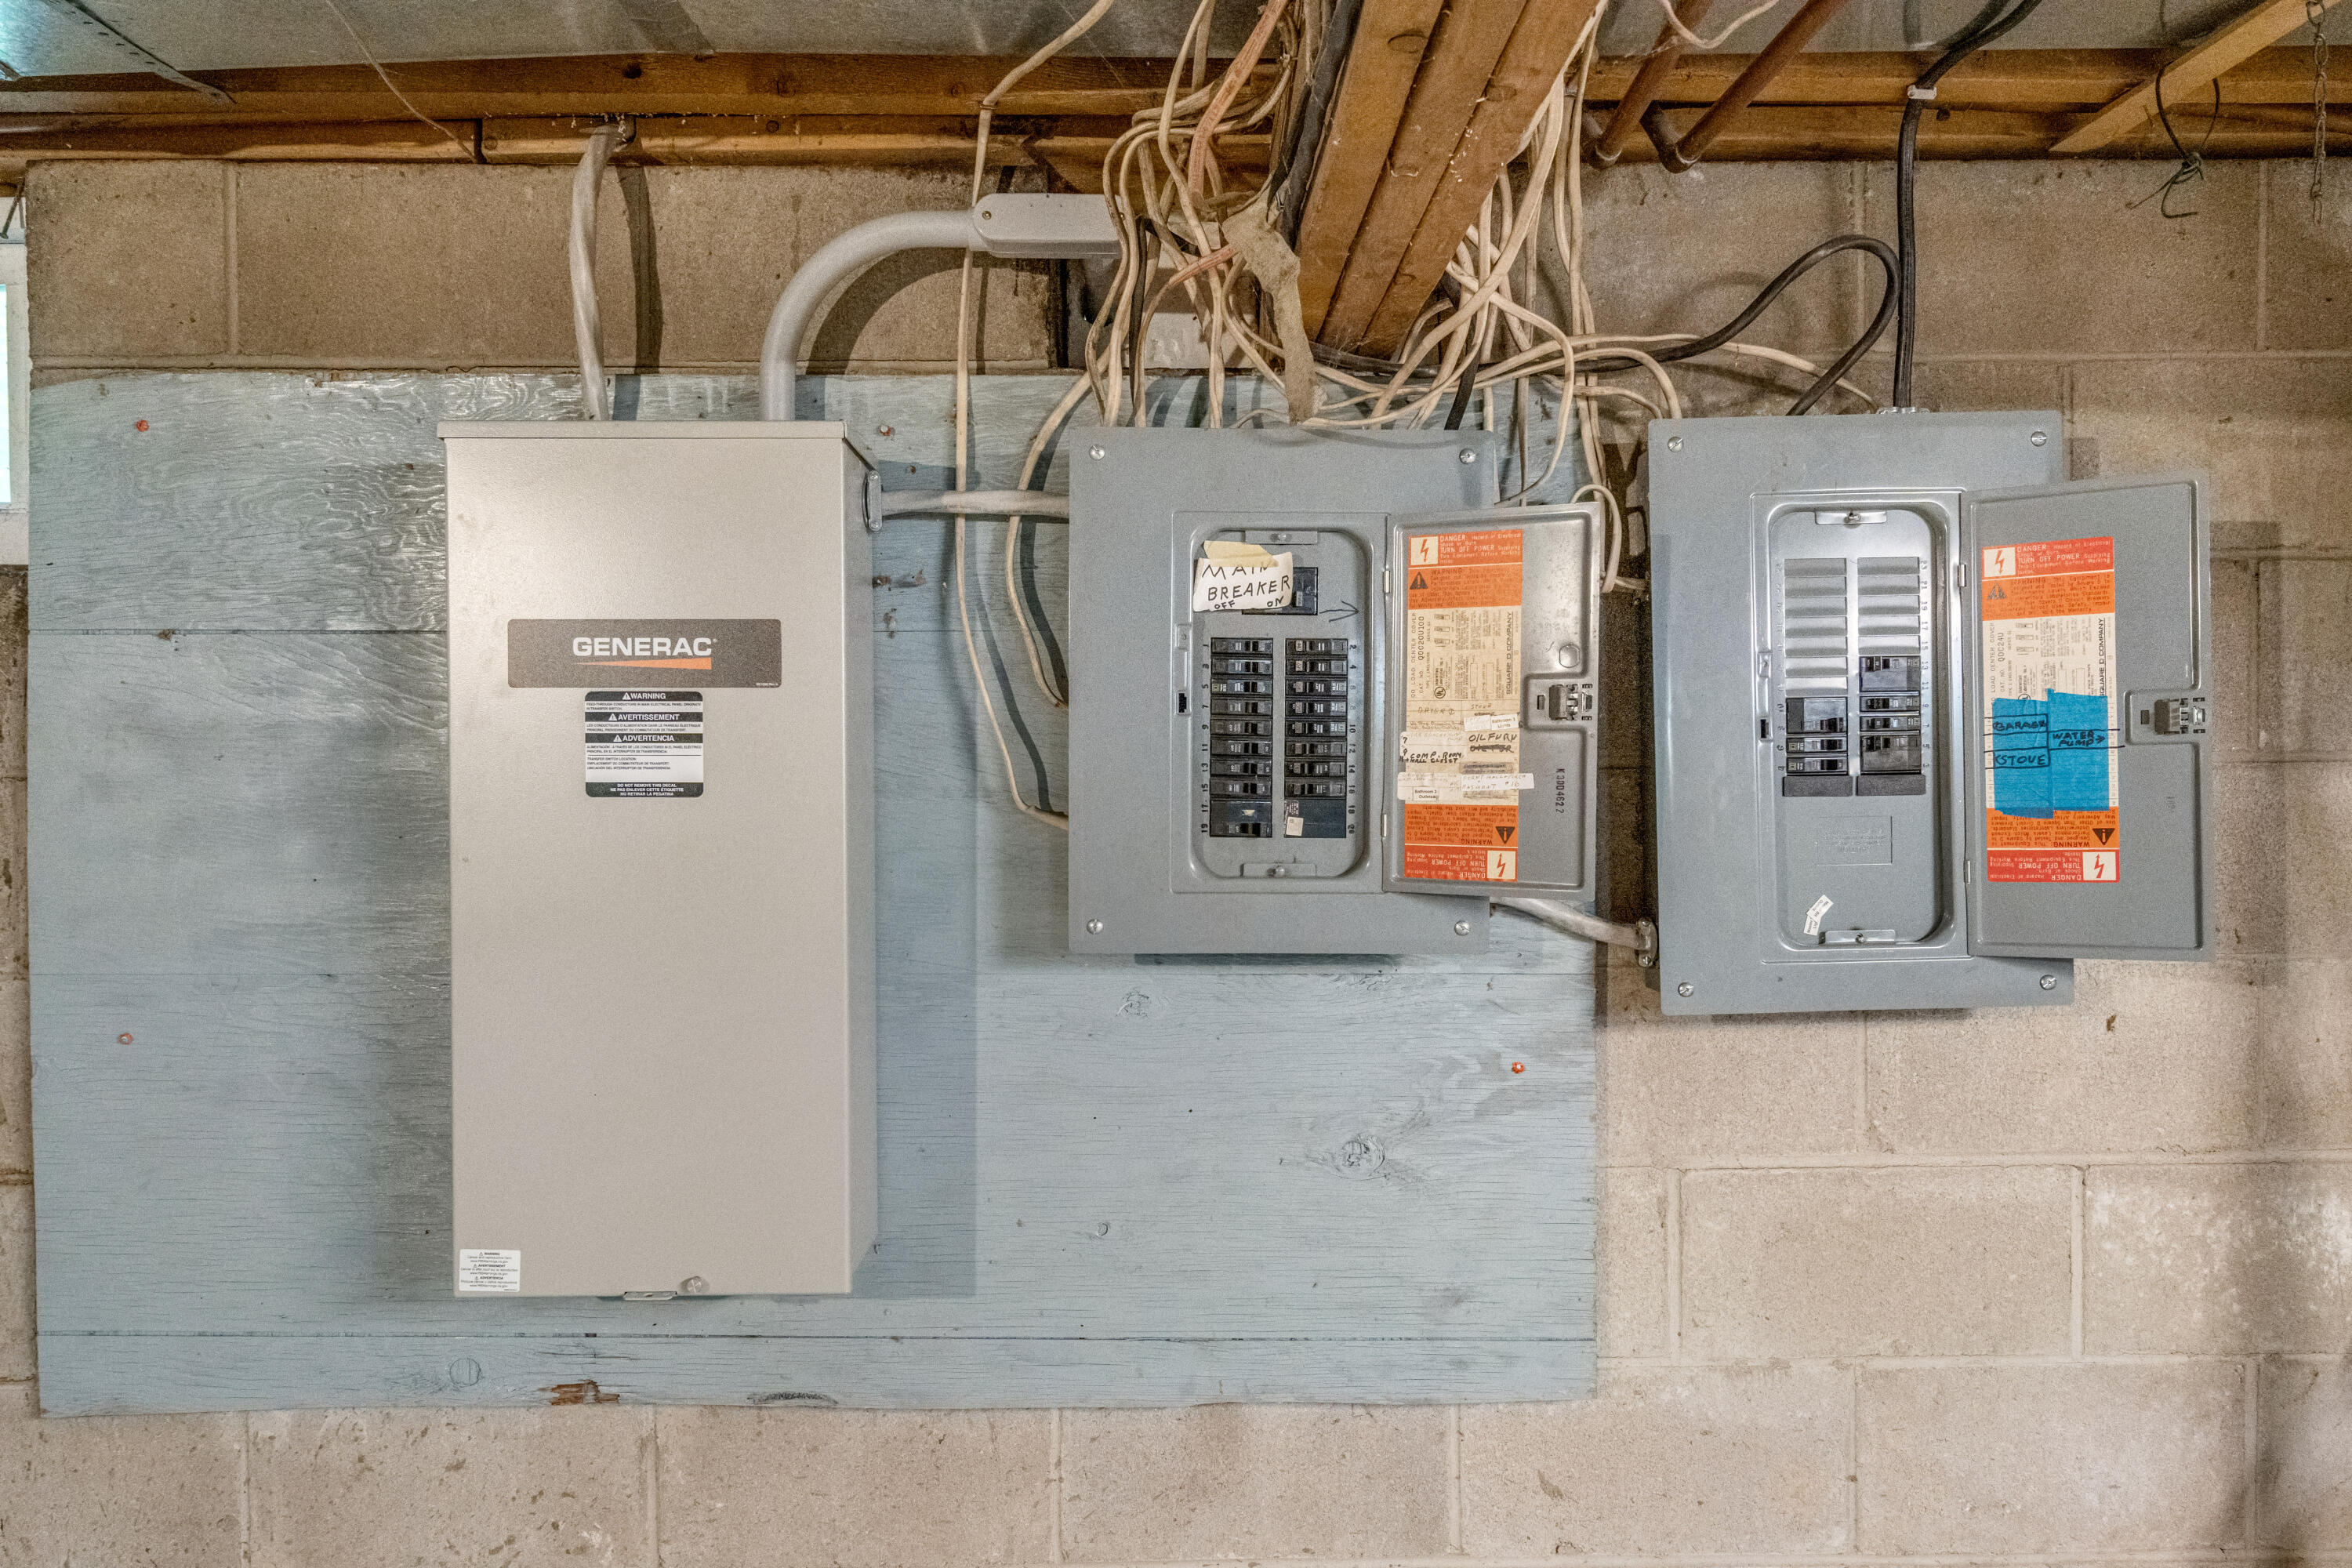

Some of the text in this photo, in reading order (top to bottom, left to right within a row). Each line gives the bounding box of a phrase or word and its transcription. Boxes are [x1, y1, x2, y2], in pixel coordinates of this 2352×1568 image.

[1207, 575, 1290, 601] BREAKER
[1214, 596, 1284, 609] OFF ON
[1921, 601, 1928, 611] 19
[1921, 621, 1928, 631] 17
[572, 637, 712, 656] GENERAC
[1921, 641, 1928, 651] 15
[1349, 724, 1356, 734] 10
[1993, 720, 2046, 731] GARAGE
[1468, 734, 1486, 742] OIL
[2053, 731, 2095, 740] WATER
[2059, 739, 2094, 747] PUMP
[1348, 744, 1356, 753] 12
[1202, 763, 1209, 772] 13
[1348, 764, 1356, 774] 14
[1202, 783, 1209, 793] 15
[1348, 785, 1356, 794] 16
[1202, 803, 1209, 813] 17
[1348, 804, 1356, 815] 18
[1202, 823, 1209, 833] 19
[1348, 824, 1356, 835] 20
